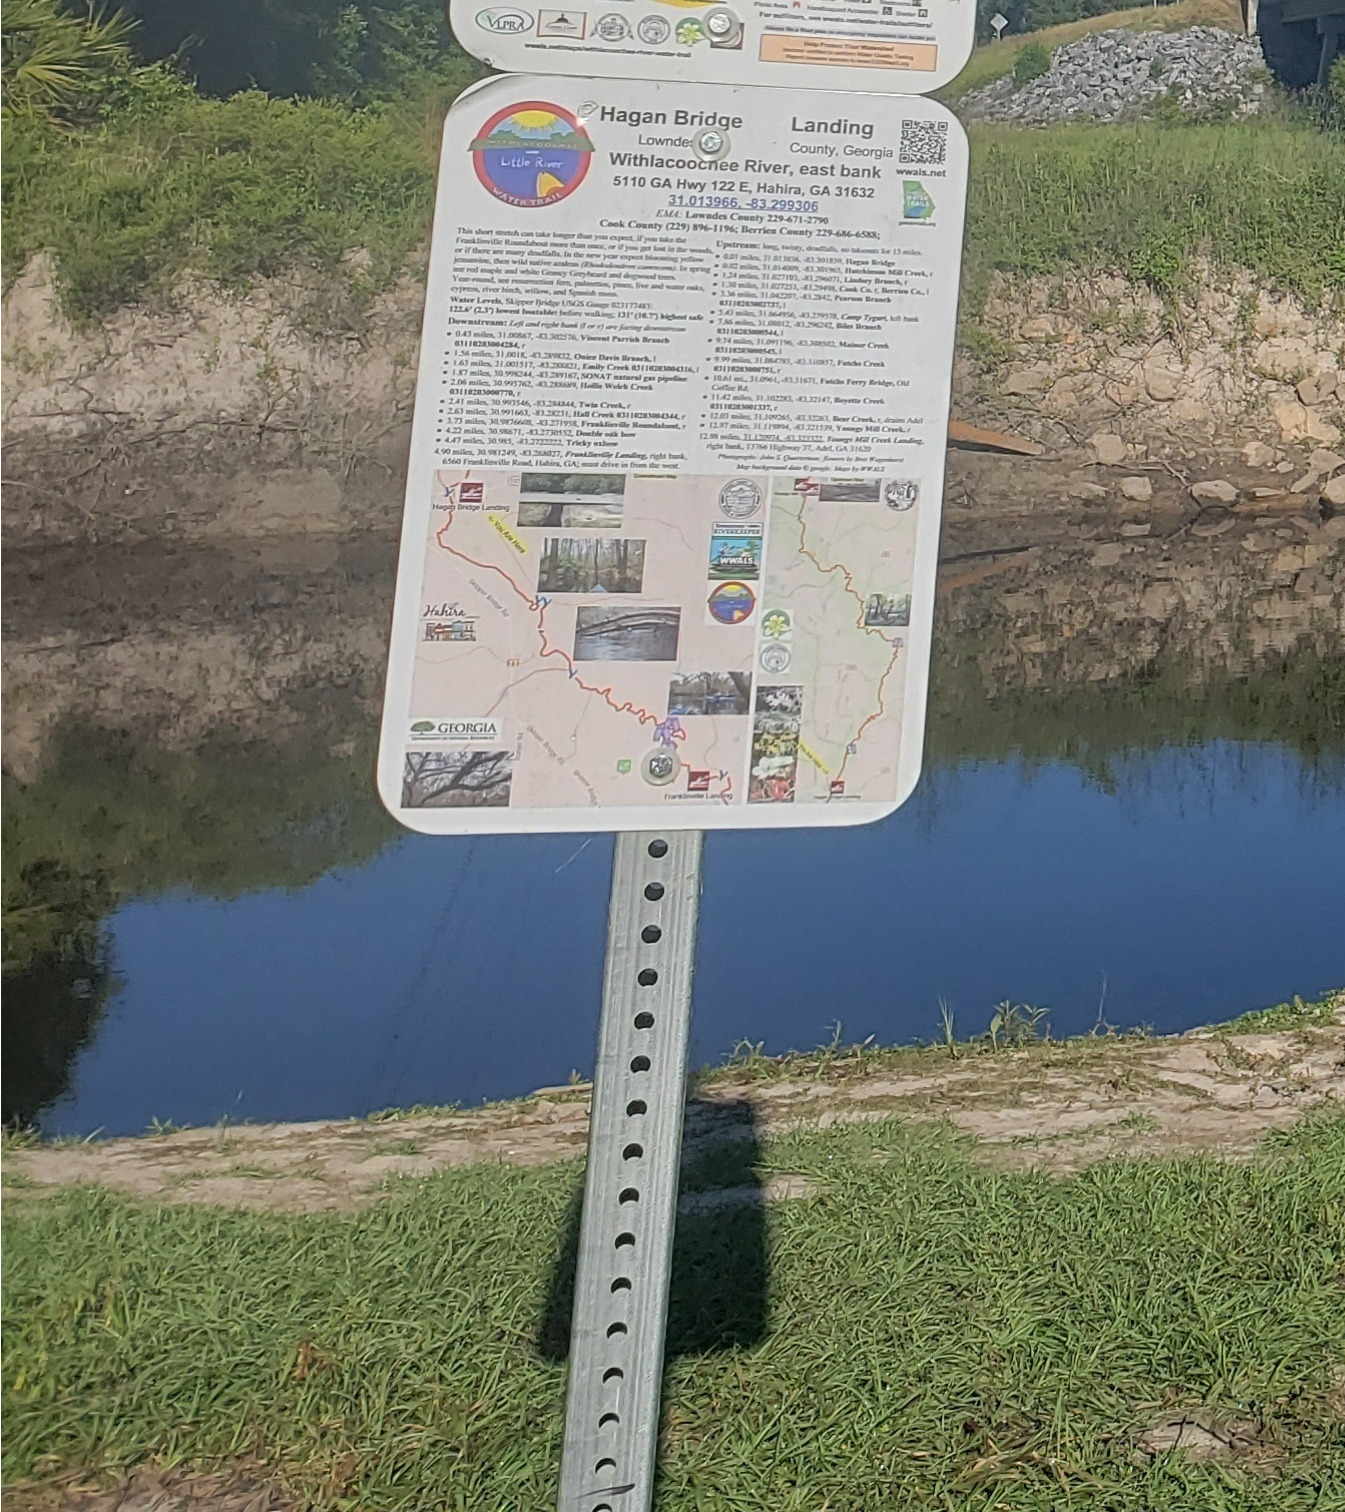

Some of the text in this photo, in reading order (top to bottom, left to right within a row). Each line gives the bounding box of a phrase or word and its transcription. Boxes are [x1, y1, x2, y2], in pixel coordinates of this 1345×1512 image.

[598, 105, 874, 139] Hagan Bridge Landing
[788, 141, 839, 158] County,
[842, 144, 894, 160] Georgia
[500, 155, 564, 169] Little River
[744, 158, 795, 176] River,
[799, 162, 836, 177] east
[839, 163, 882, 179] bank
[895, 166, 947, 178] wwals.net
[611, 174, 875, 198] 5110 GA Hwy 122 E, Hahira, GA 31632
[491, 186, 563, 207] WATER TRAIL
[667, 193, 819, 212] 31.013966, -83.299306
[684, 210, 727, 221] Lowndes
[728, 212, 764, 224] County
[766, 214, 829, 225] 229-671-2790
[599, 218, 625, 228] Cook
[627, 220, 663, 231] County
[664, 221, 690, 232] (229)
[691, 223, 738, 234] 896-1196;
[740, 225, 777, 235] Berrien
[778, 227, 813, 238] County
[449, 295, 475, 303] Water
[447, 316, 507, 326] Downstream:
[457, 503, 480, 511] Bridge
[481, 504, 510, 512] Landing
[719, 556, 754, 564] WWALS
[422, 602, 467, 618] Hahira
[437, 722, 497, 733] GEORGIA
